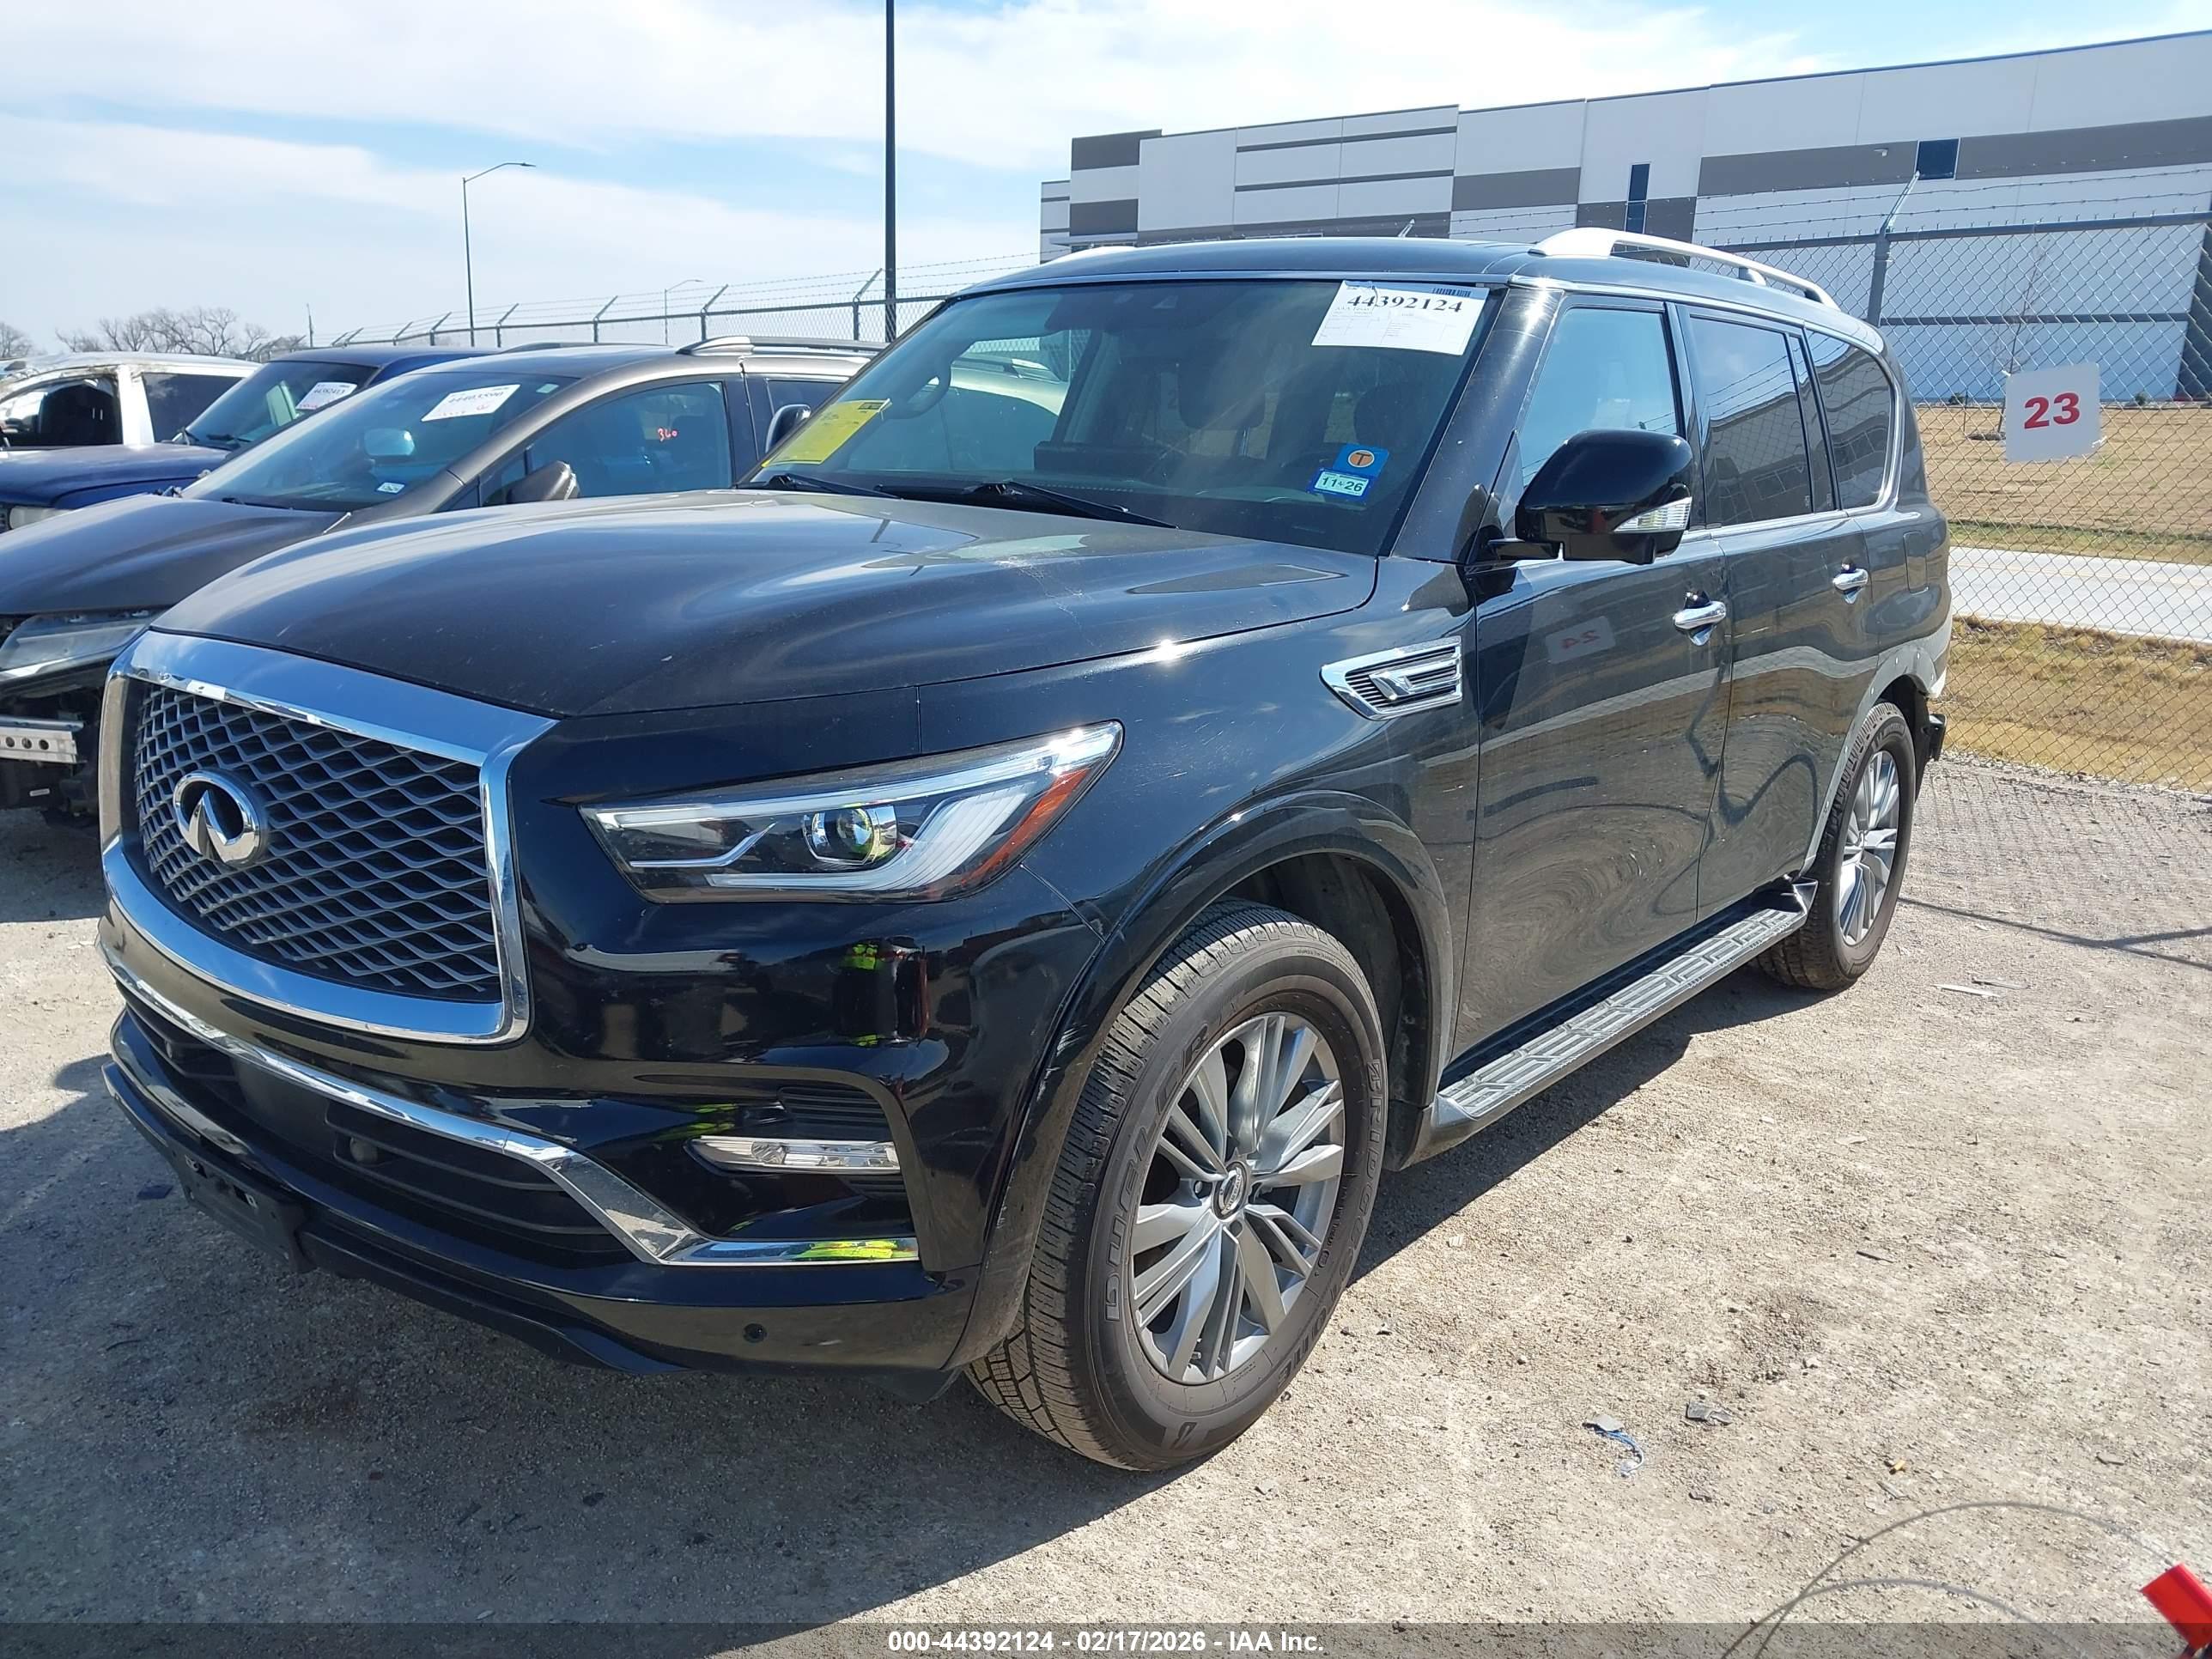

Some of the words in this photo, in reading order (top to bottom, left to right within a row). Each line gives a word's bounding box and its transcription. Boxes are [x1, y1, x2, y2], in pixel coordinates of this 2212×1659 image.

[1347, 295, 1462, 313] 44392124
[2023, 392, 2081, 429] 23
[1355, 451, 1371, 466] T
